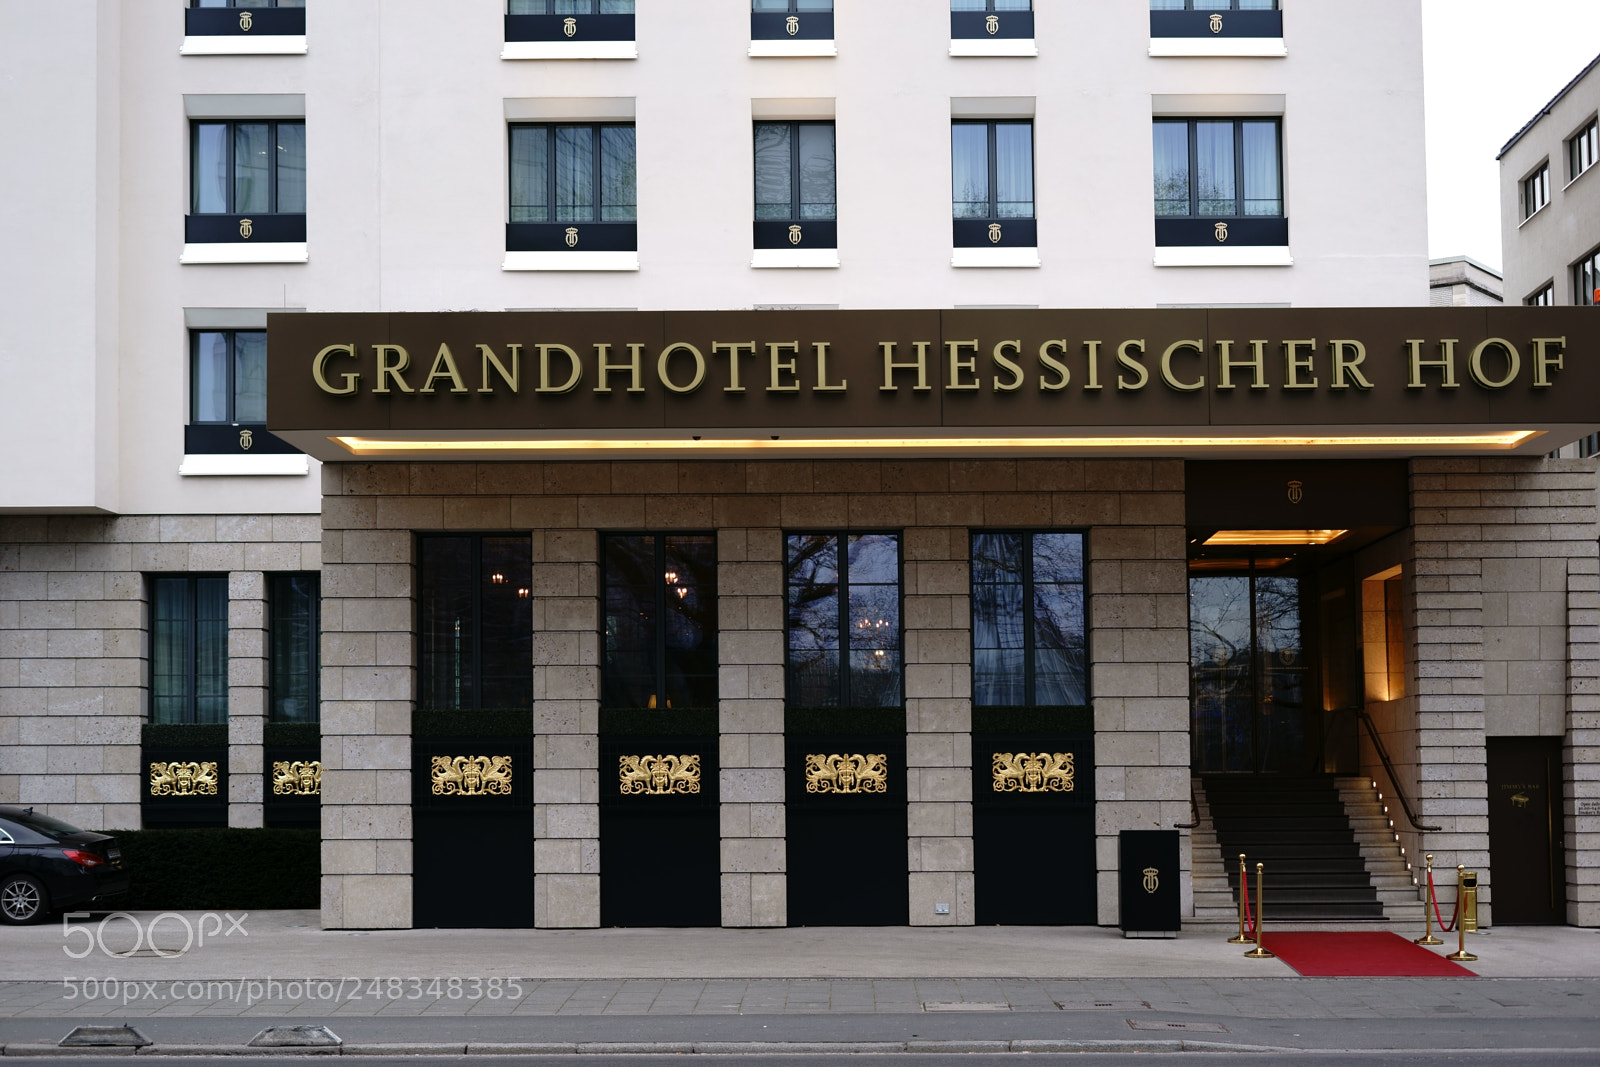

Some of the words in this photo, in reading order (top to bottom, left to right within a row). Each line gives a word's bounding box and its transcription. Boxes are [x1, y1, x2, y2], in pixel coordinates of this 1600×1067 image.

[312, 340, 847, 394] GRANDHOTEL
[878, 338, 1374, 392] HESSISCHER
[1406, 336, 1567, 390] HOF
